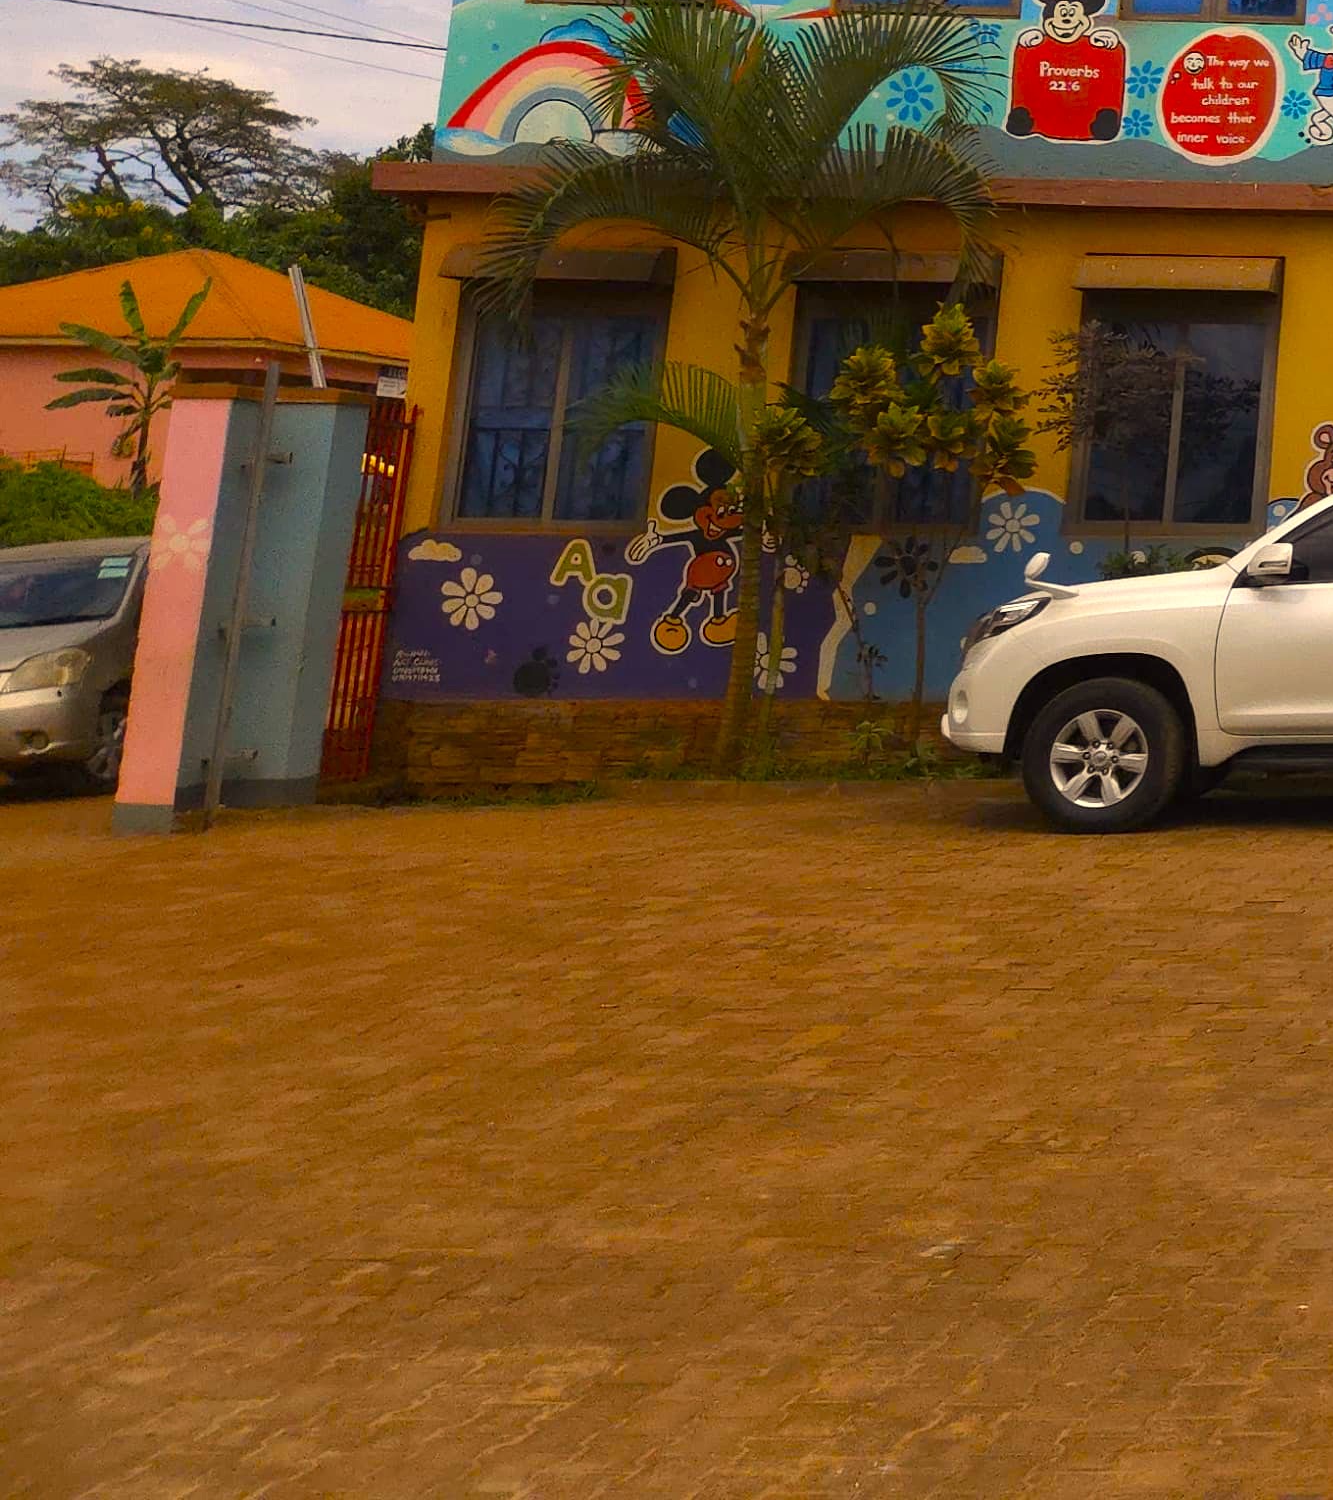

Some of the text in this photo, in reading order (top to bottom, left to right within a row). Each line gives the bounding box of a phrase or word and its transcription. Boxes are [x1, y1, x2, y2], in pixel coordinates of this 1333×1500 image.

[1039, 61, 1100, 79] Proverbs
[1227, 59, 1250, 71] way
[1253, 60, 1270, 68] we
[1049, 80, 1081, 92] 22:6
[1191, 76, 1259, 90] talk to our
[1201, 93, 1251, 106] children
[1170, 111, 1257, 125] becomes their
[1176, 132, 1209, 143] inner
